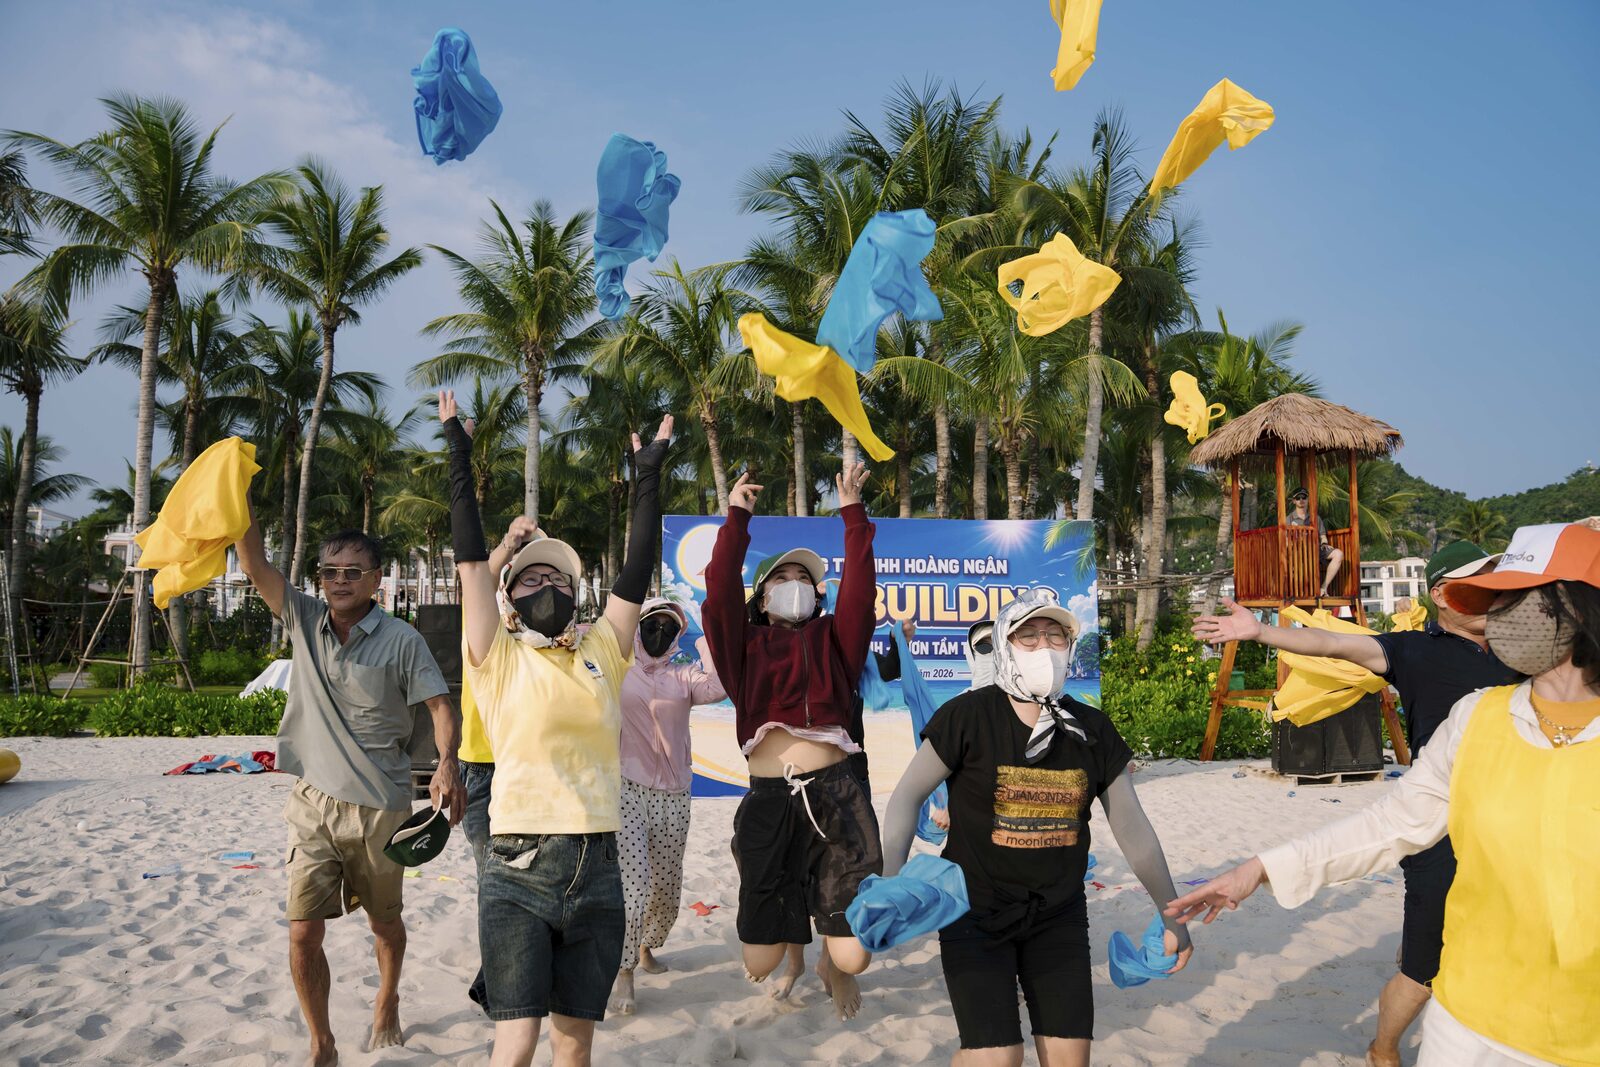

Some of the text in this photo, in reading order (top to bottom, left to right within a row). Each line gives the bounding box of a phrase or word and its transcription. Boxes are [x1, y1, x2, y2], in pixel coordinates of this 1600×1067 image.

[904, 555, 959, 574] HOÀNG
[964, 555, 1008, 575] NGÂN
[874, 585, 1056, 622] UILDI
[933, 668, 954, 678] 2026
[1007, 788, 1073, 804] DIAMONDS
[1008, 807, 1065, 818] GLITTER
[1006, 835, 1064, 847] moonlight
